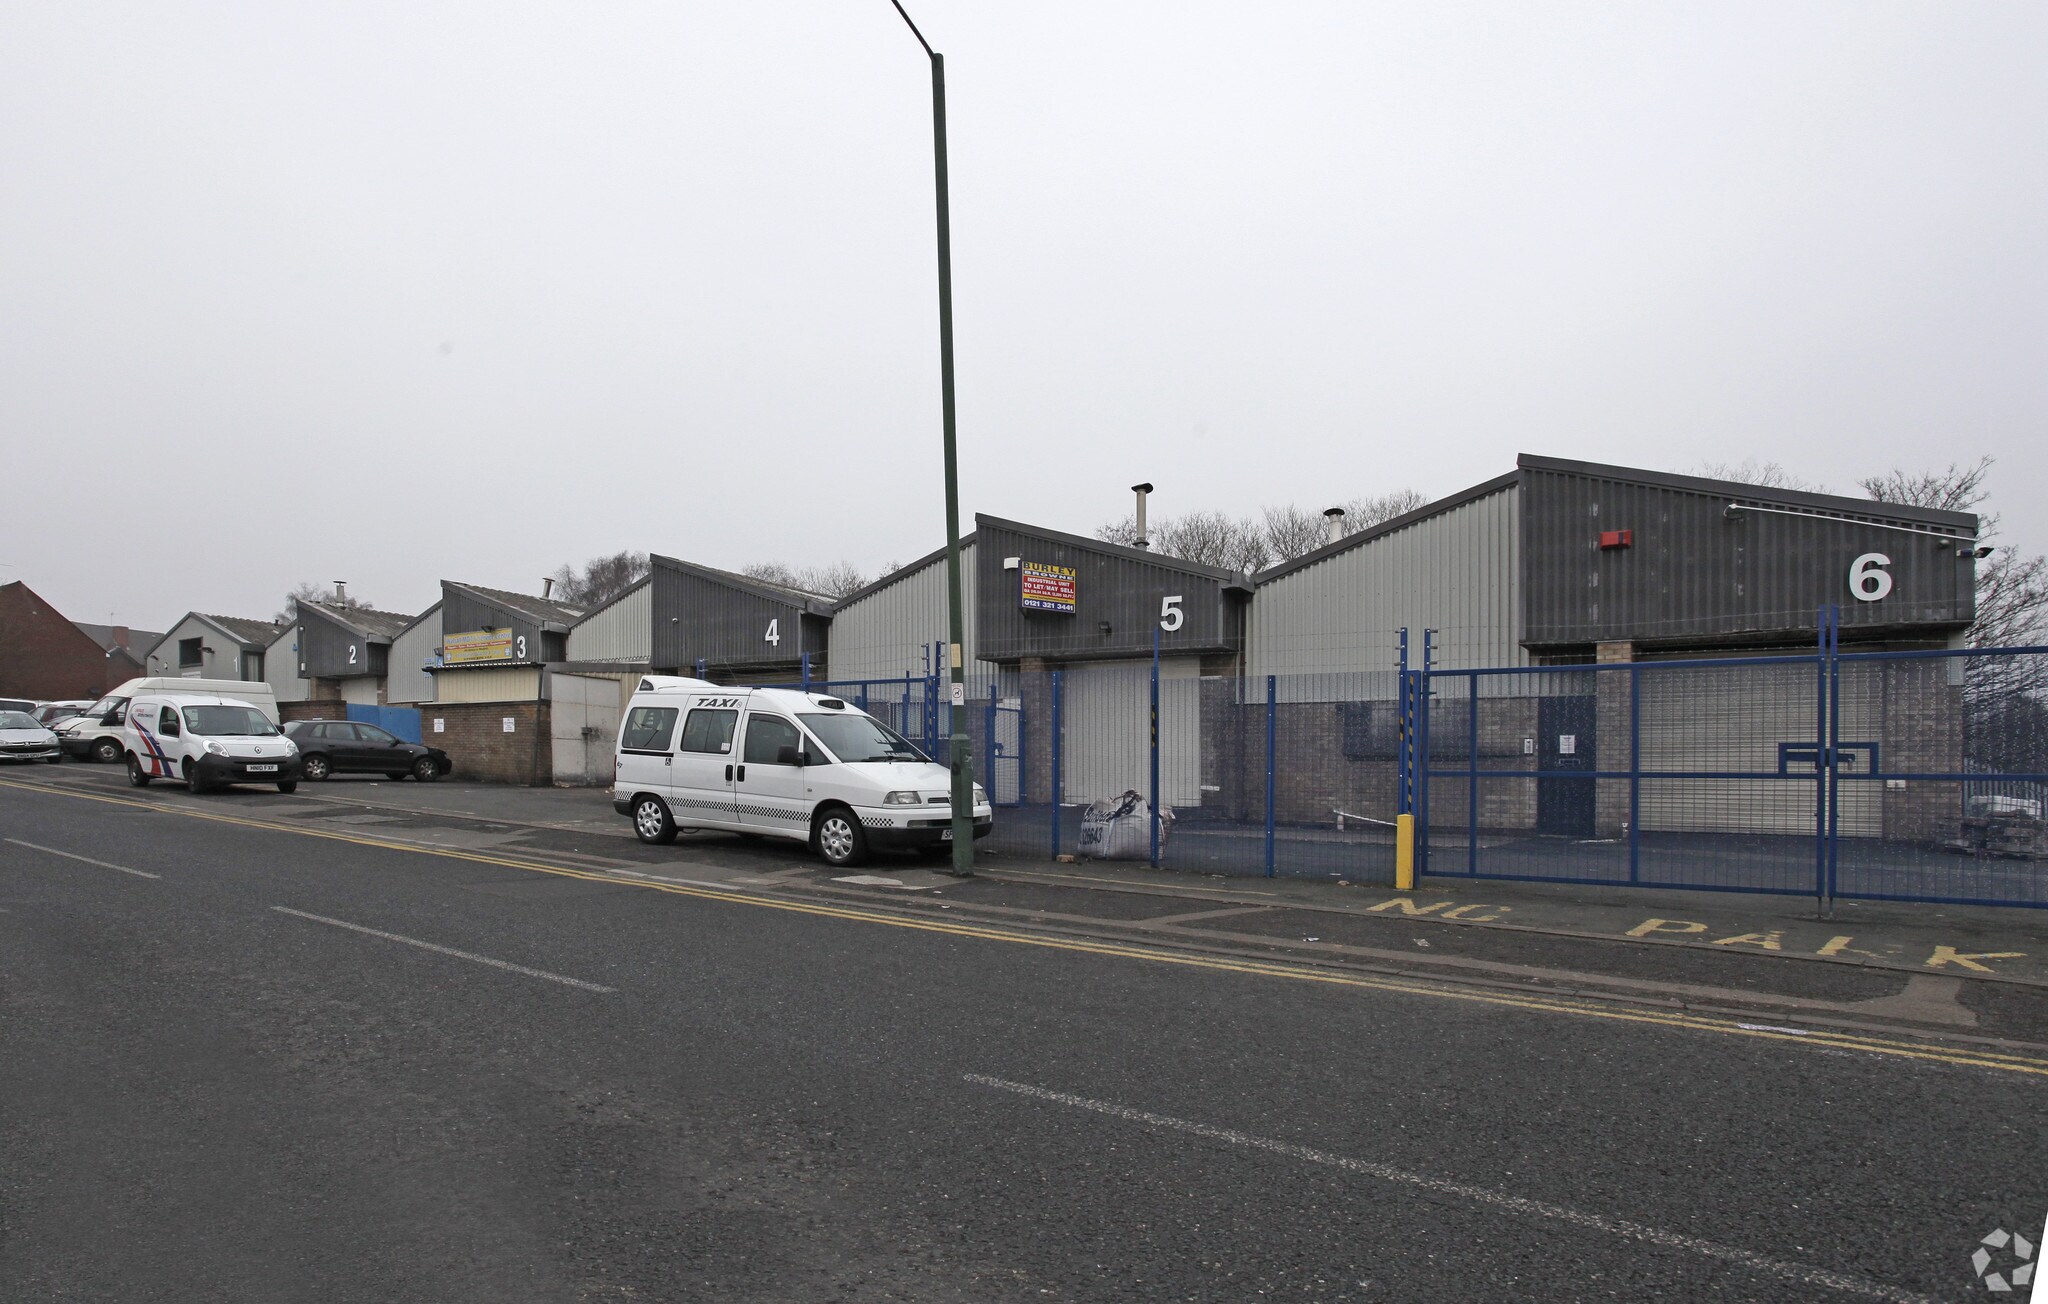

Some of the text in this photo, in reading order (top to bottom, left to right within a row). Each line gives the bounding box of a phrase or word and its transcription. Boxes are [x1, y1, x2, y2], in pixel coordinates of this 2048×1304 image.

[1024, 562, 1074, 575] BURLEY
[1024, 570, 1073, 580] BROWNE
[1849, 552, 1892, 601] 6
[1027, 577, 1057, 585] INDUSTRIAL
[1057, 603, 1073, 611] 3441
[1160, 595, 1184, 631] 5
[765, 618, 780, 646] 4
[349, 645, 357, 664] 2
[517, 635, 526, 659] 3
[233, 656, 239, 673] 1
[697, 698, 739, 708] TAXI
